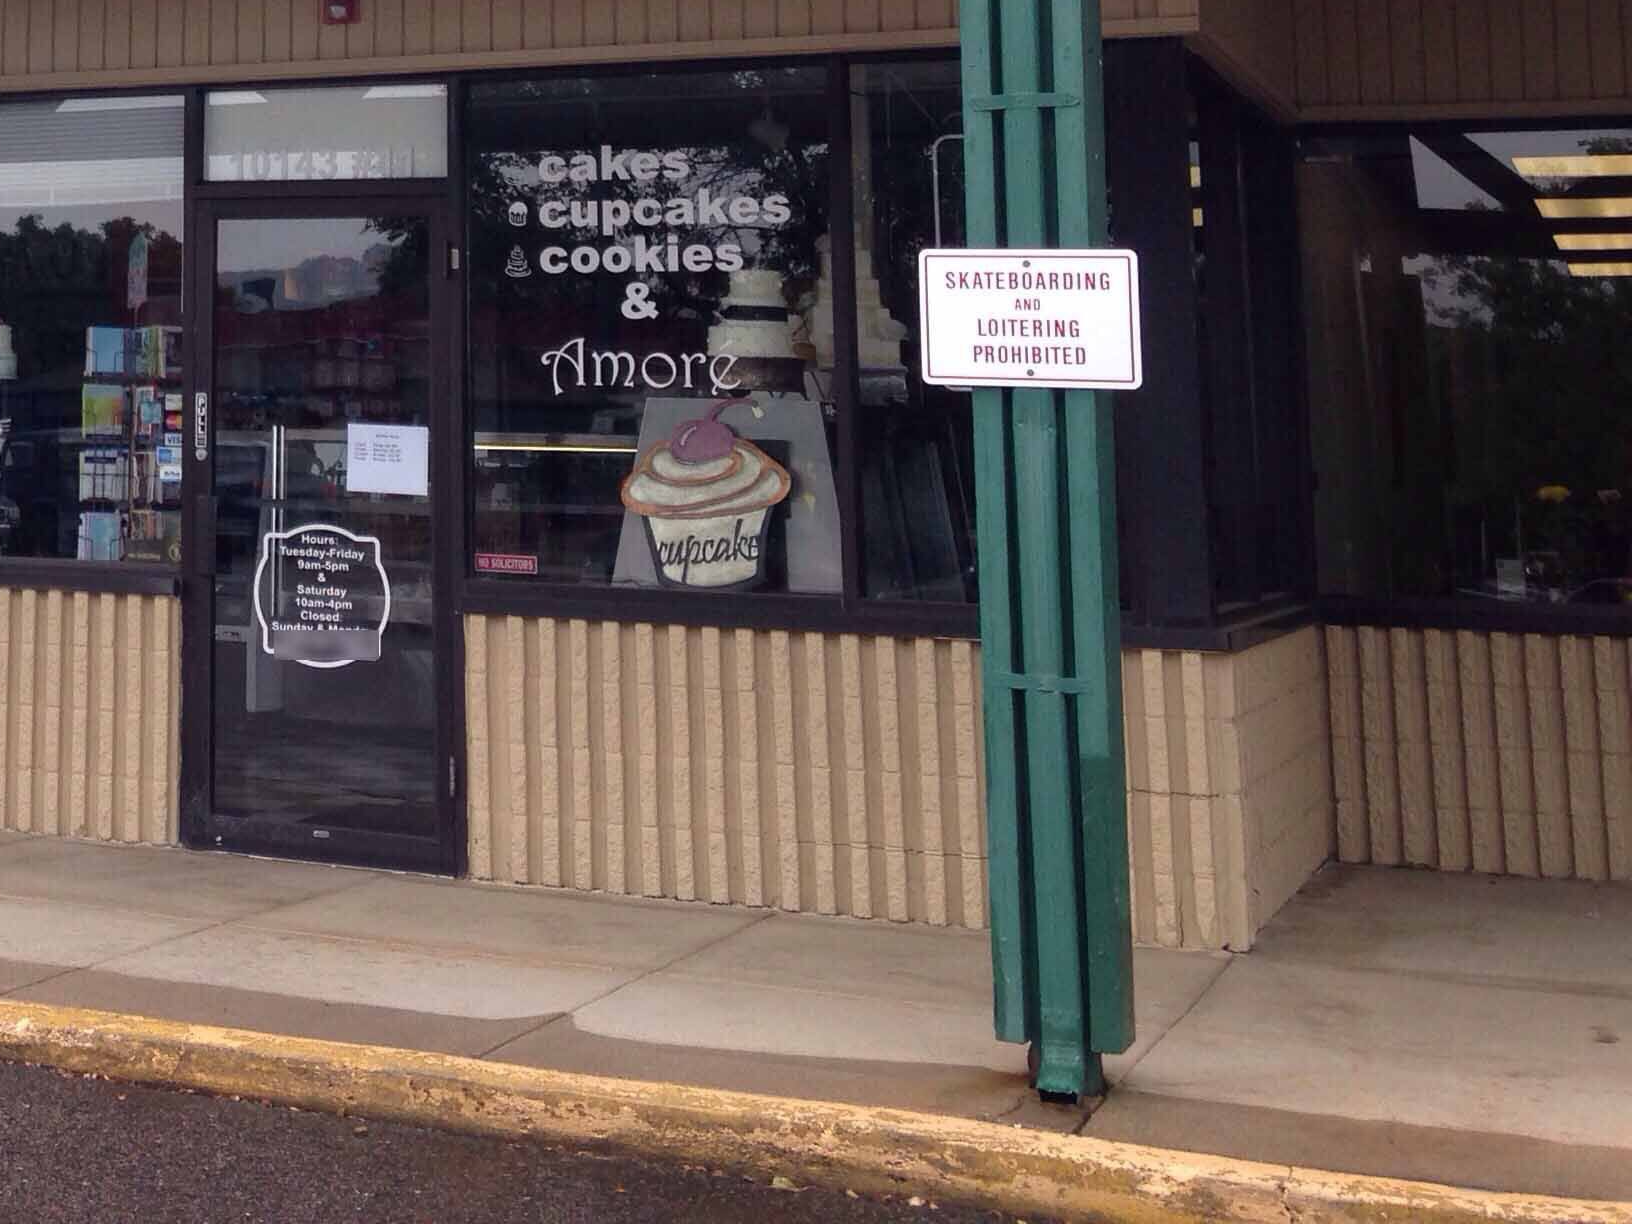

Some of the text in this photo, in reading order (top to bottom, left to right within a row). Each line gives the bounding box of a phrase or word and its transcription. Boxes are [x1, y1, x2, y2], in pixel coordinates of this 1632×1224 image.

[538, 145, 690, 182] cakes
[538, 188, 791, 236] cupcakes
[539, 235, 744, 274] cookies
[944, 271, 1111, 291] SKATEBOARDING
[620, 282, 659, 320] &
[1014, 298, 1041, 311] AND
[976, 318, 1081, 338] LOITERING
[972, 344, 1087, 365] PROHIBITED
[167, 434, 182, 445] VIS
[279, 546, 365, 561] Tuesday-Friday
[297, 559, 349, 572] 9am-5pm
[317, 572, 326, 582] &
[296, 584, 347, 598] Saturday
[295, 598, 353, 610] 10am-4pm
